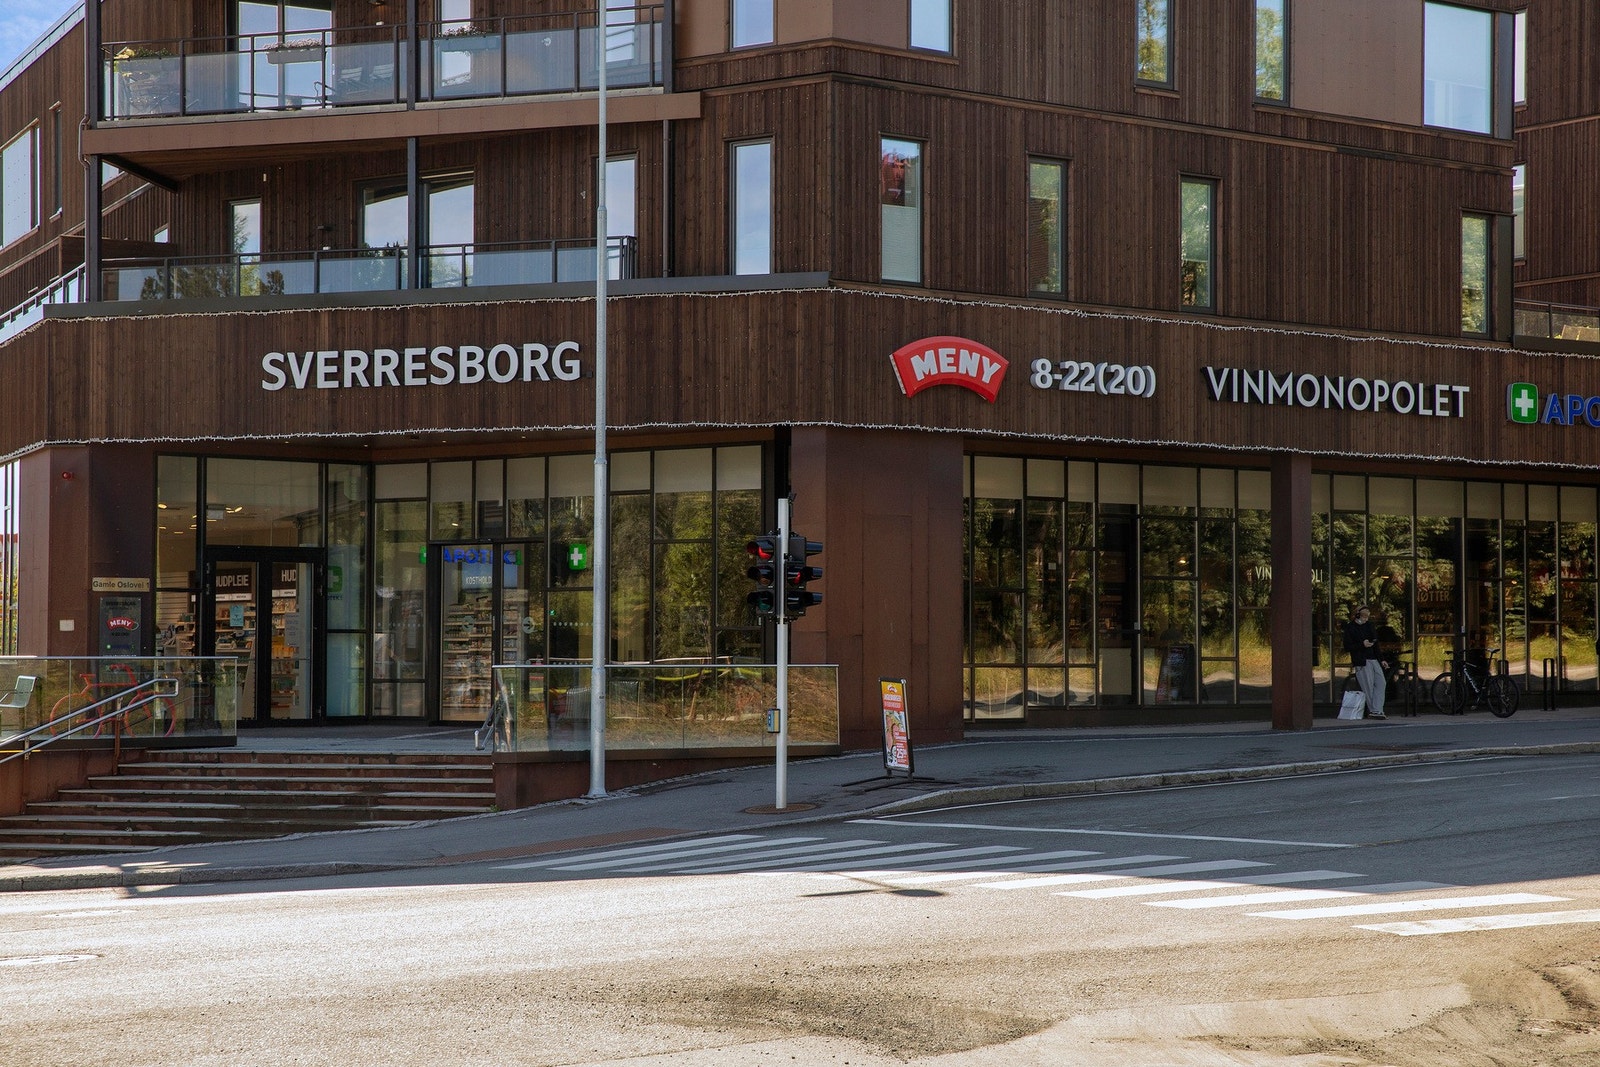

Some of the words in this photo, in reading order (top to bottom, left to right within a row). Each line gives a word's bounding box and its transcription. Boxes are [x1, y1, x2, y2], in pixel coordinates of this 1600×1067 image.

[261, 341, 580, 391] SVERRESBORG
[910, 347, 1002, 384] MENY
[1032, 358, 1156, 398] 8-22(20)
[1205, 366, 1470, 418] VINMONOPOLET
[1542, 392, 1600, 428] APO
[92, 580, 116, 588] Gamle
[109, 619, 132, 627] MENY
